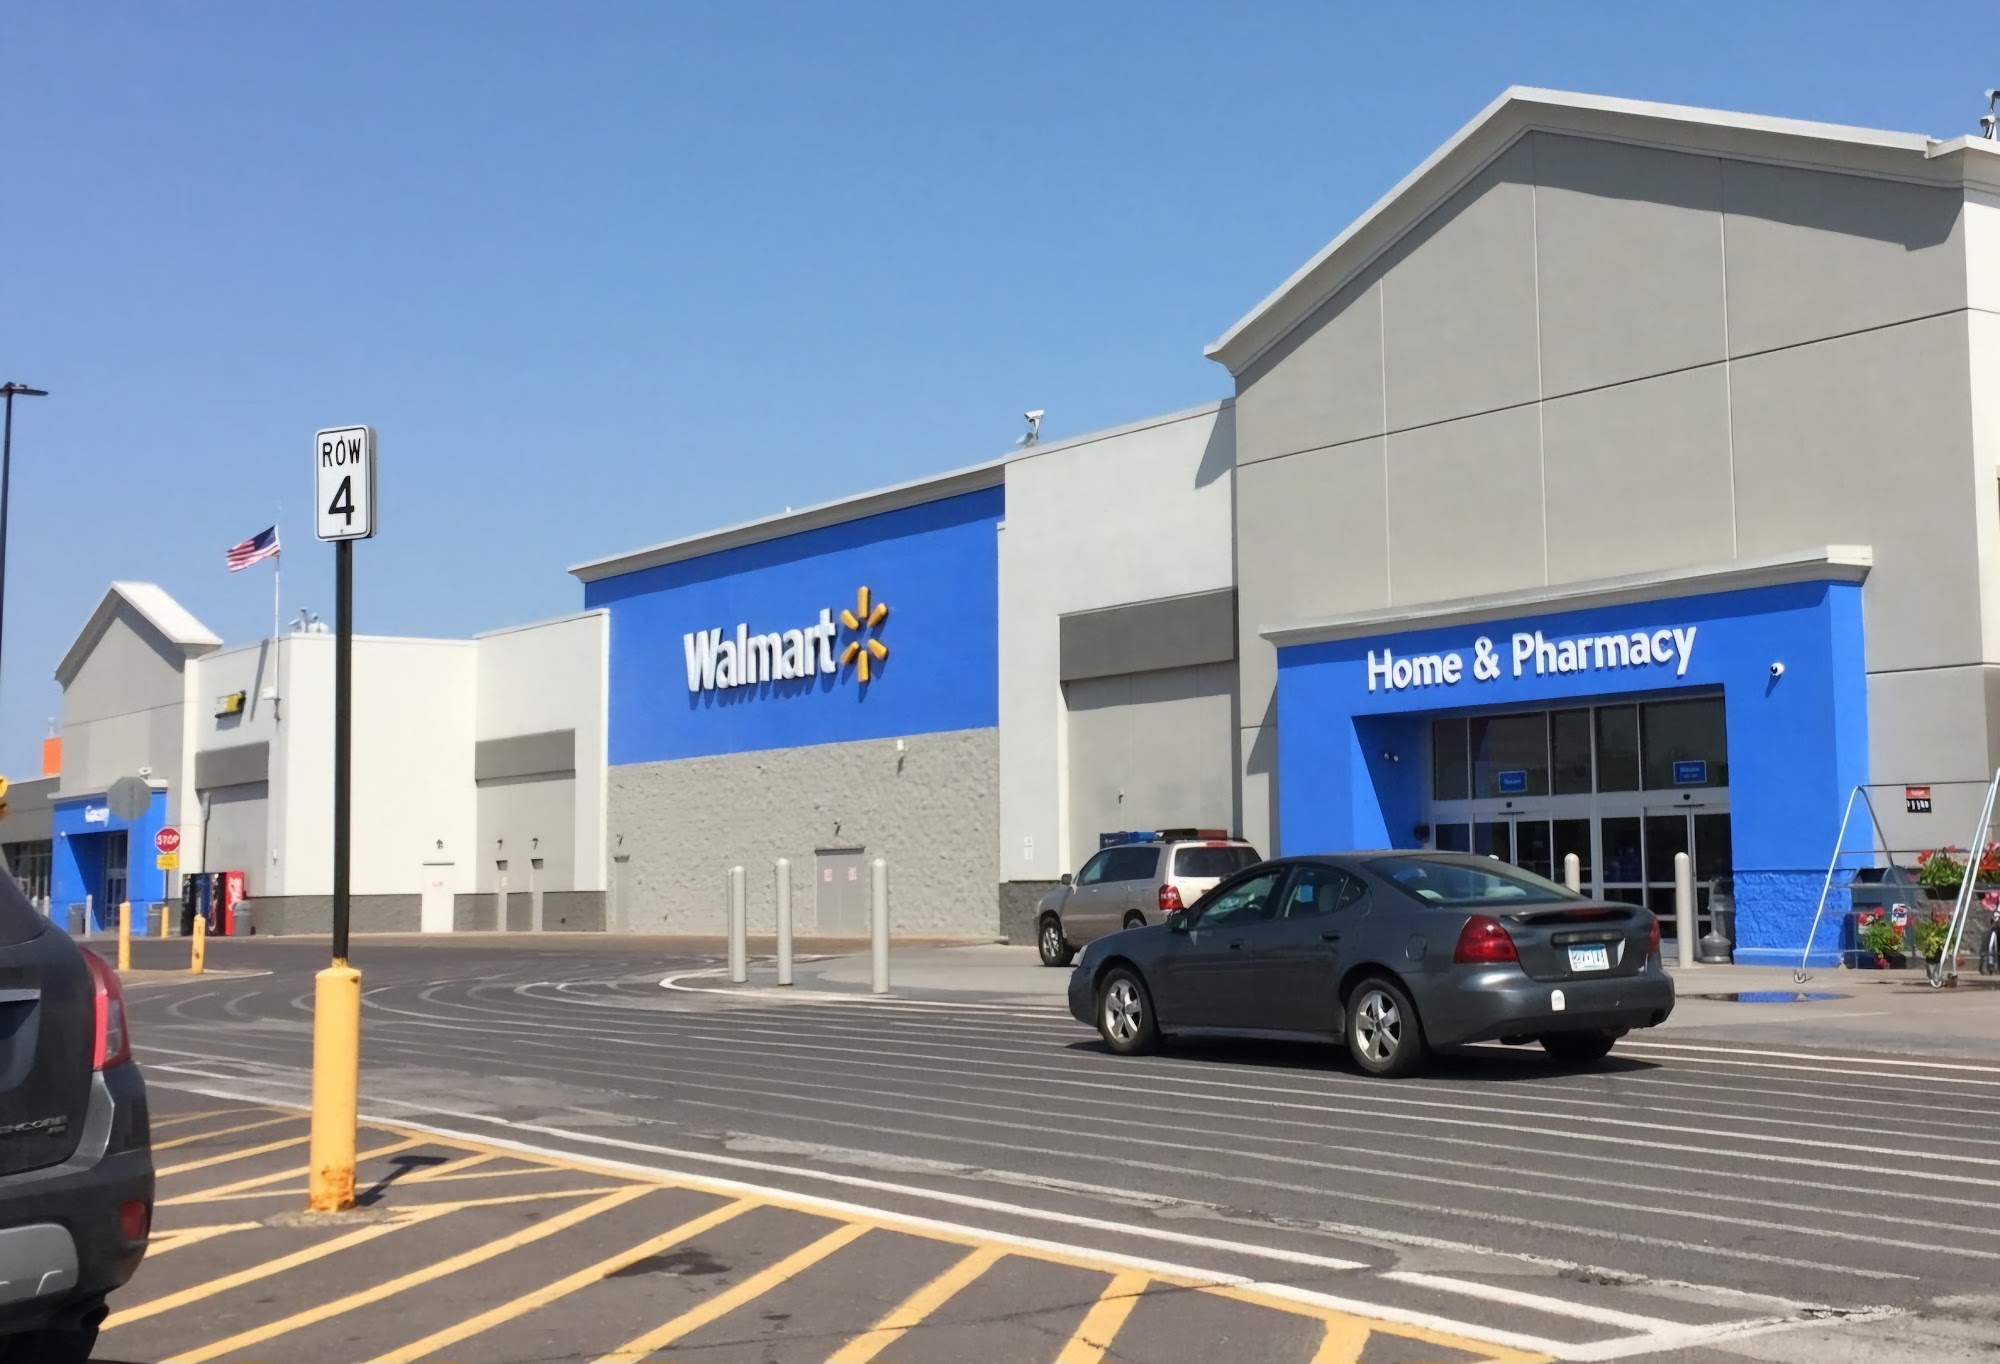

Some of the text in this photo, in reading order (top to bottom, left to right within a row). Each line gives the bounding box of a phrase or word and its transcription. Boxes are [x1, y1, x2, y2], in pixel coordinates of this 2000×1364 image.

[322, 438, 361, 468] ROW
[328, 475, 355, 526] 4
[683, 608, 836, 692] Walmart
[1367, 626, 1697, 692] Home & Pharmacy
[157, 834, 180, 846] STOP
